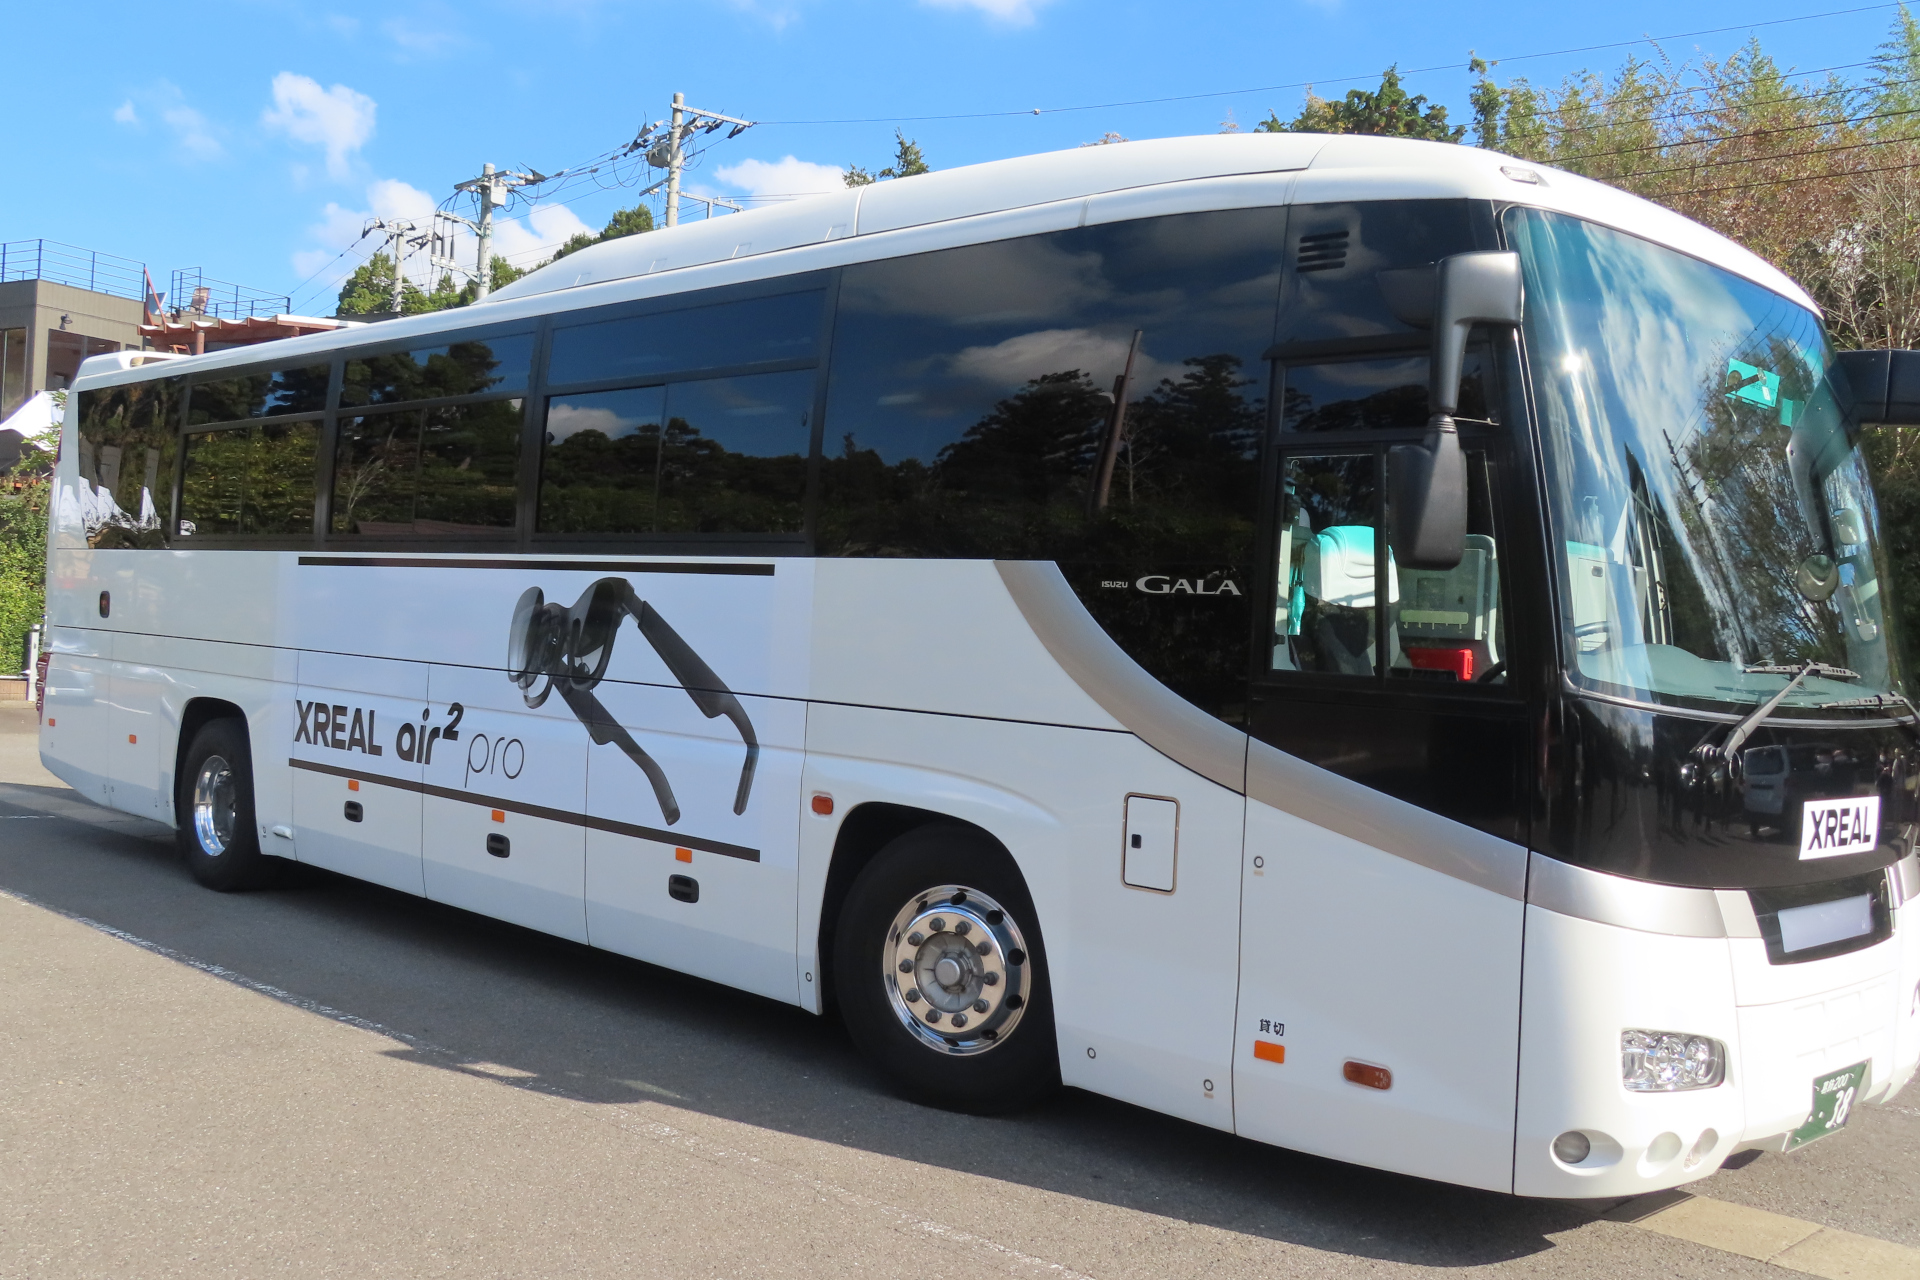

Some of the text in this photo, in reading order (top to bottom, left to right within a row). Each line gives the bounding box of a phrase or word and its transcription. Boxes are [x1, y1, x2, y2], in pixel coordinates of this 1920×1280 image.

[1101, 575, 1242, 596] ISUZU GALA
[295, 700, 382, 756] XREAL
[464, 733, 525, 789] pro
[1808, 806, 1871, 851] XREAL
[1259, 1018, 1285, 1037] 貸切
